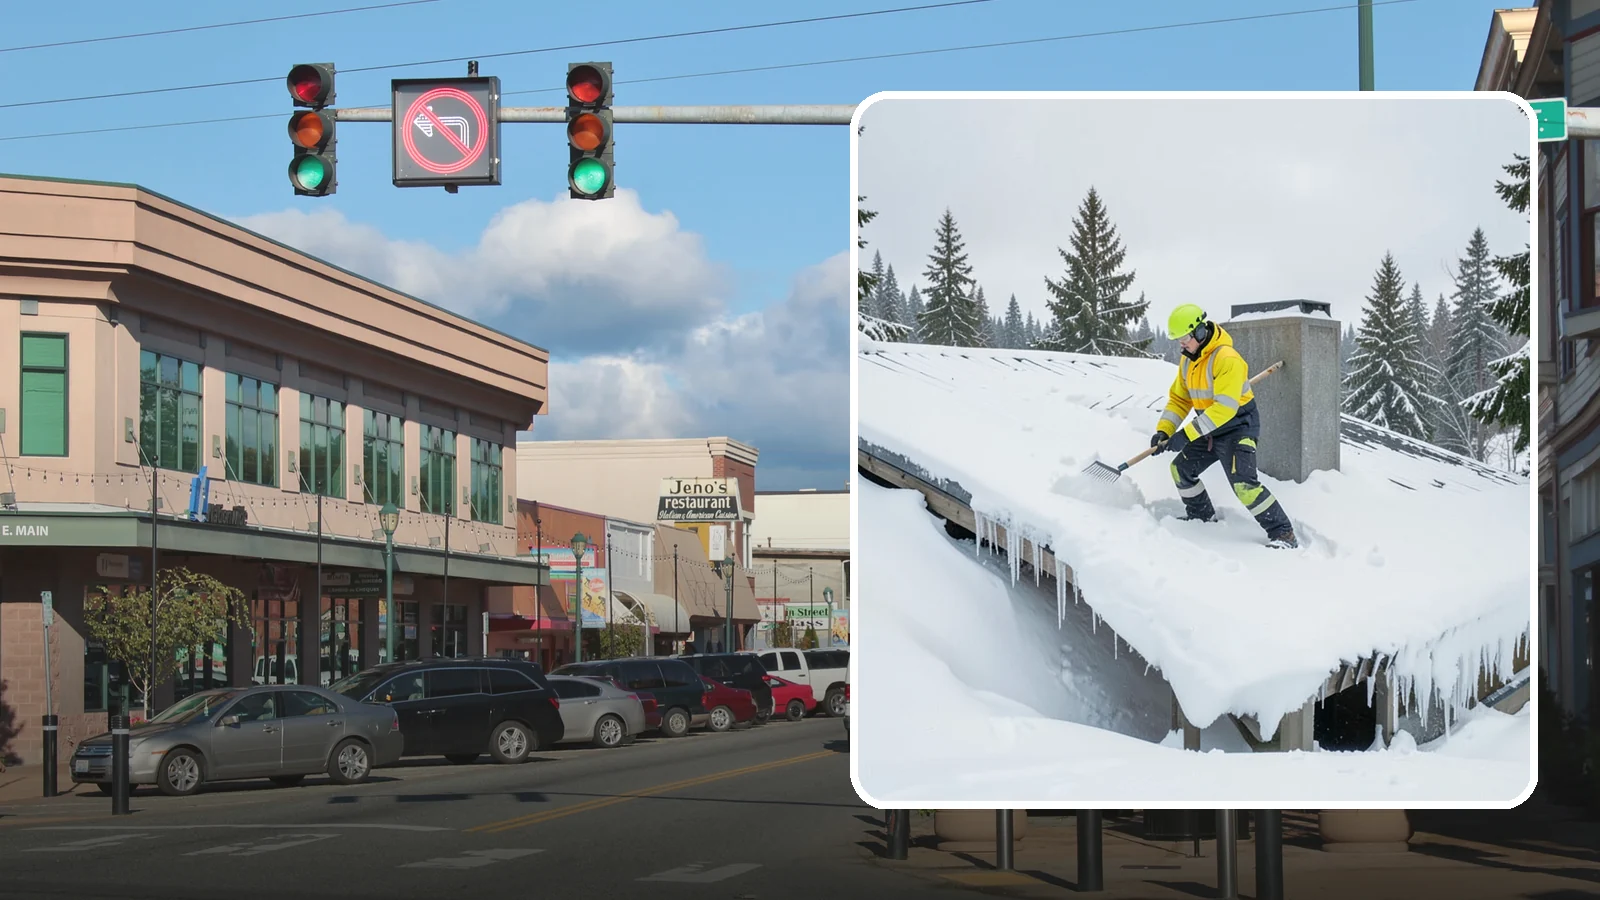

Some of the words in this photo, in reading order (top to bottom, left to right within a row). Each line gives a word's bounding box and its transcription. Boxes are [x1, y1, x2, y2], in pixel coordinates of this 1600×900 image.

[669, 480, 728, 495] Jeno's
[665, 496, 731, 509] restaurant
[658, 510, 682, 520] Italian
[685, 509, 715, 519] American
[714, 509, 737, 519] Cuisine
[2, 525, 13, 536] E.
[15, 525, 49, 536] MAIN
[797, 607, 828, 617] Street
[791, 619, 824, 627] lass
